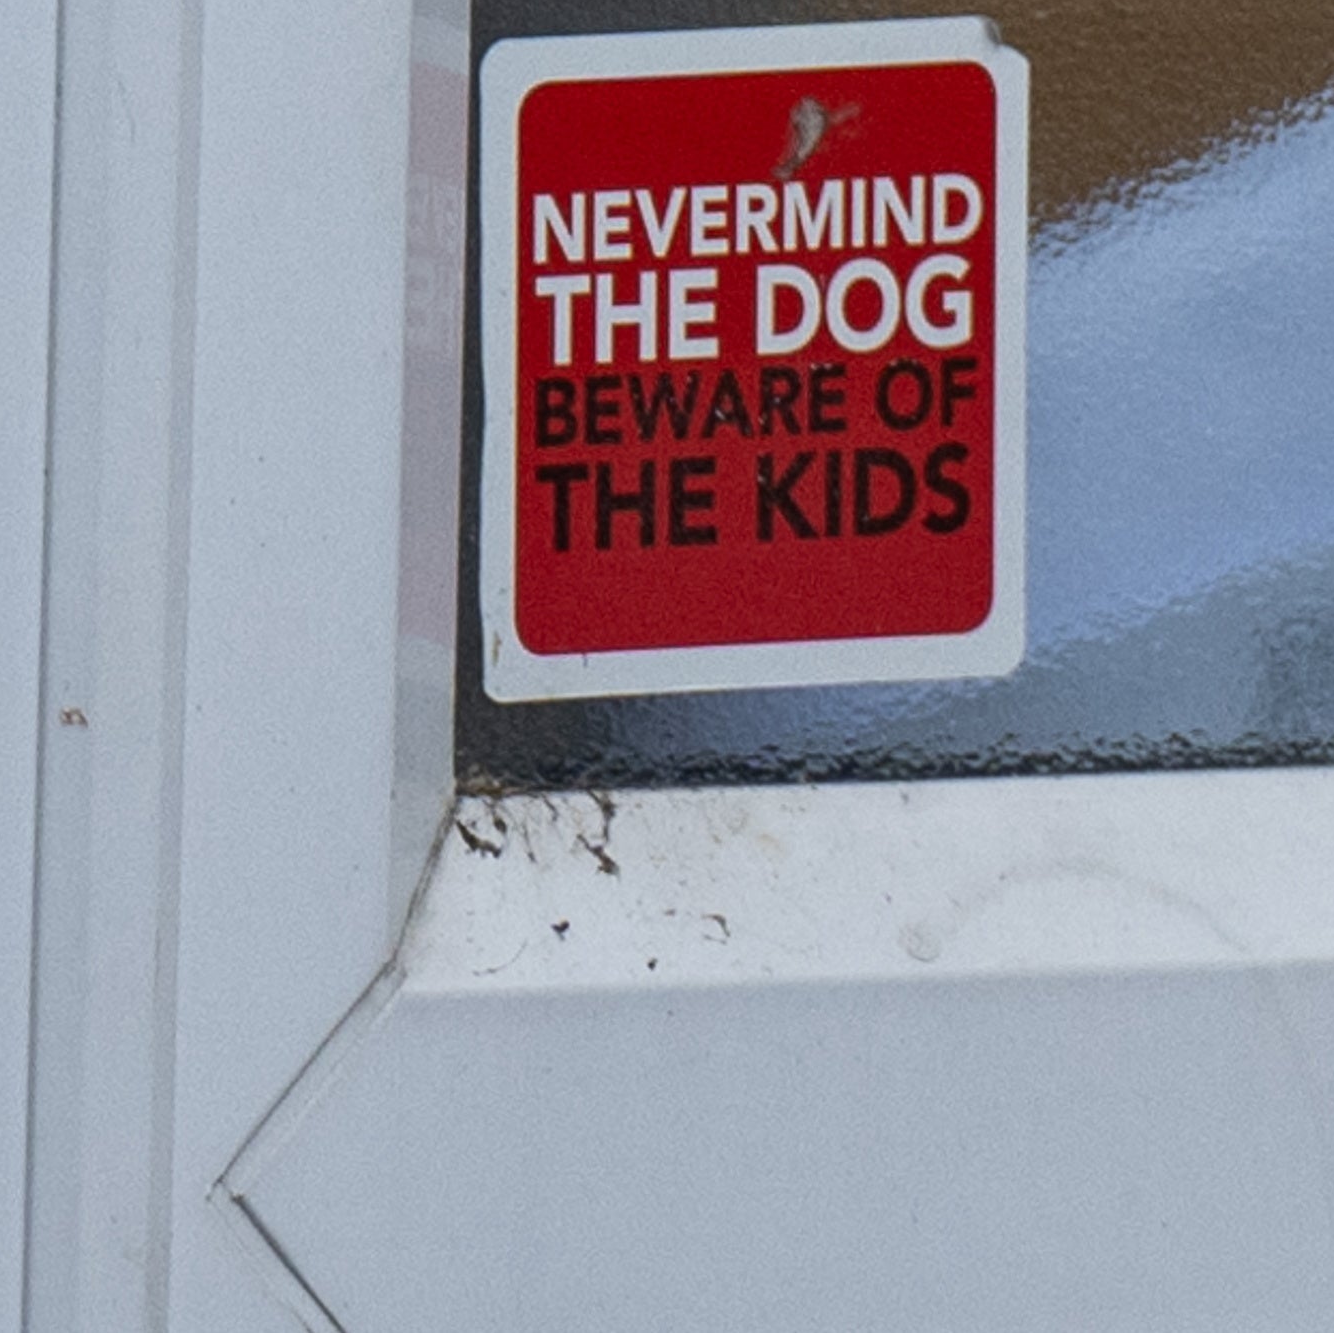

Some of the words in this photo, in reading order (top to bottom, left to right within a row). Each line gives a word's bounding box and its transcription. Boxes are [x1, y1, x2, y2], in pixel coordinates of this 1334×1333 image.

[533, 173, 983, 265] NEVERMIND
[535, 268, 719, 366] THE
[756, 253, 974, 356] DOG
[534, 363, 848, 449] BEWARE
[874, 356, 979, 432] OF
[534, 455, 719, 553] THE
[756, 441, 972, 543] KIDS
